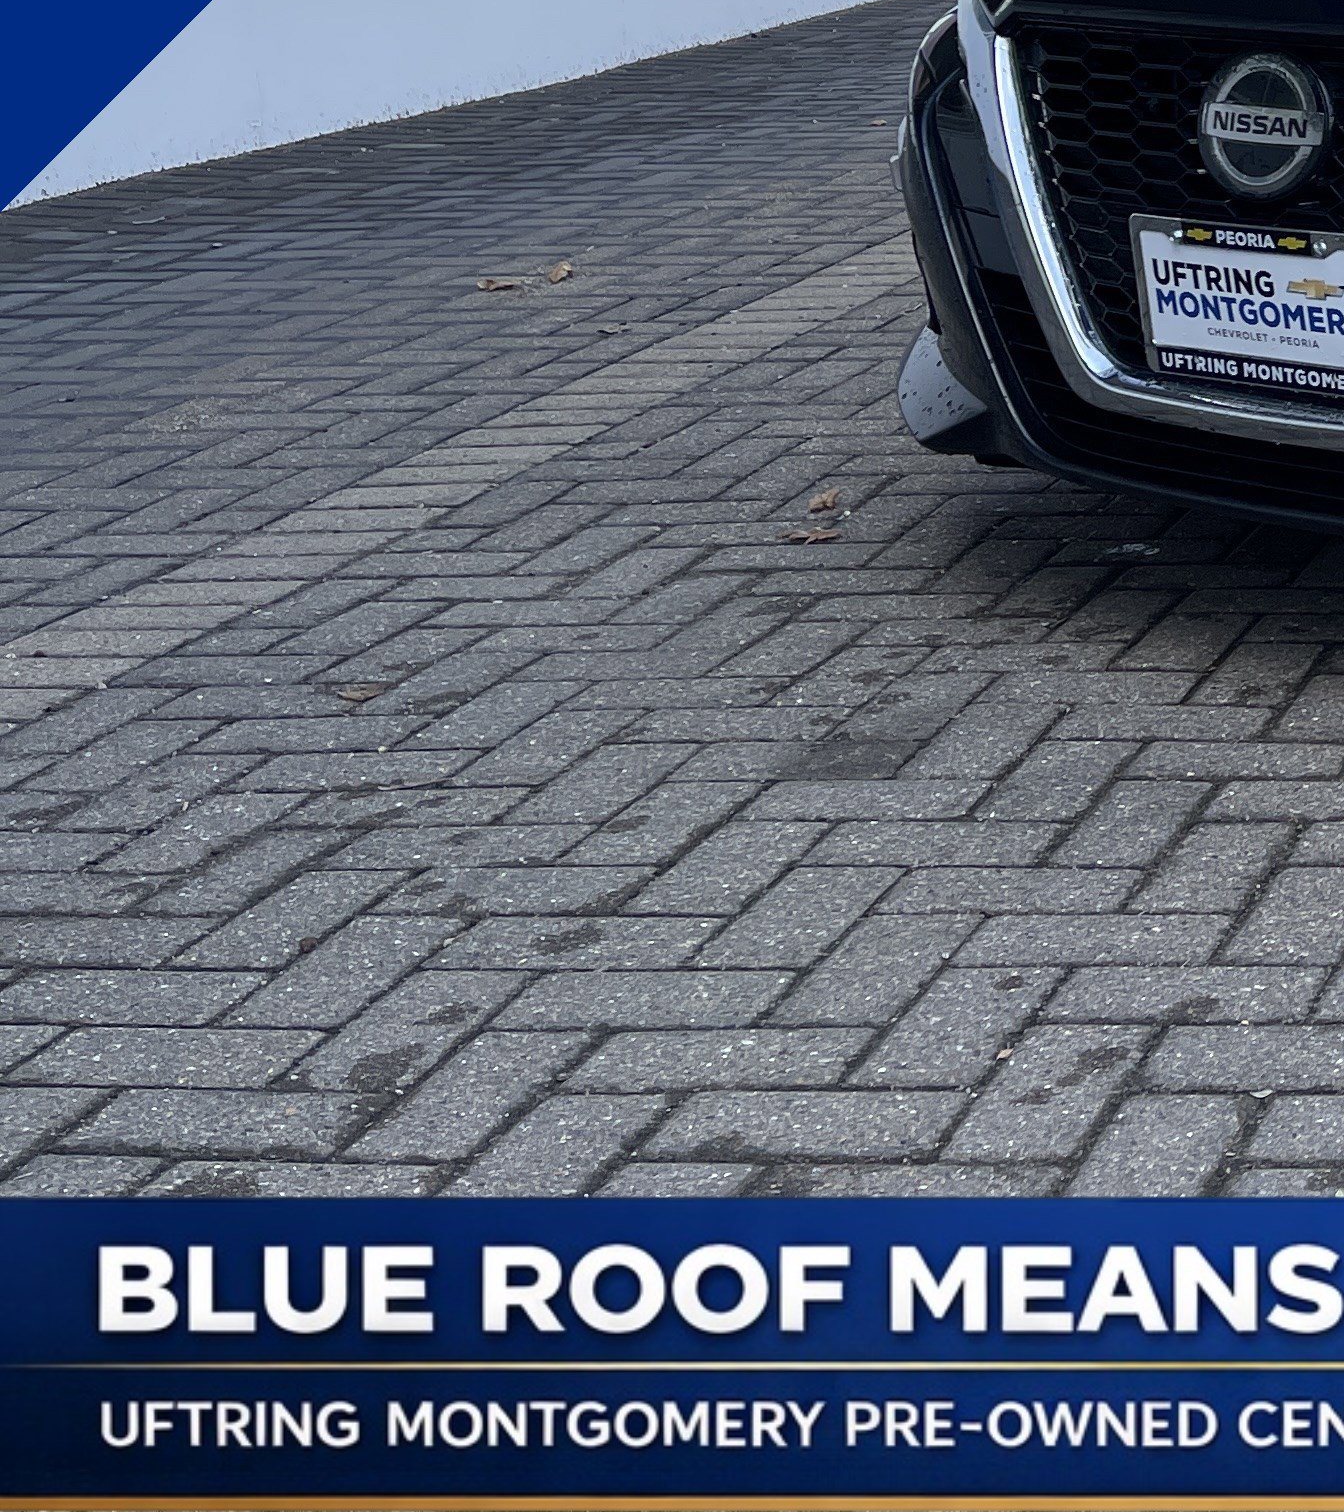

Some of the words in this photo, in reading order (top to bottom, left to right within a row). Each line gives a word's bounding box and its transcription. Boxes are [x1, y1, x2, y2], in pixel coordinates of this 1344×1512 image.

[1212, 110, 1307, 139] NISSAN
[1215, 229, 1276, 249] PEORIA
[1152, 258, 1275, 298] UFTRING
[1207, 327, 1268, 343] CHEVROLET
[1279, 336, 1320, 349] PEORIA
[1162, 352, 1238, 376] UFTRING
